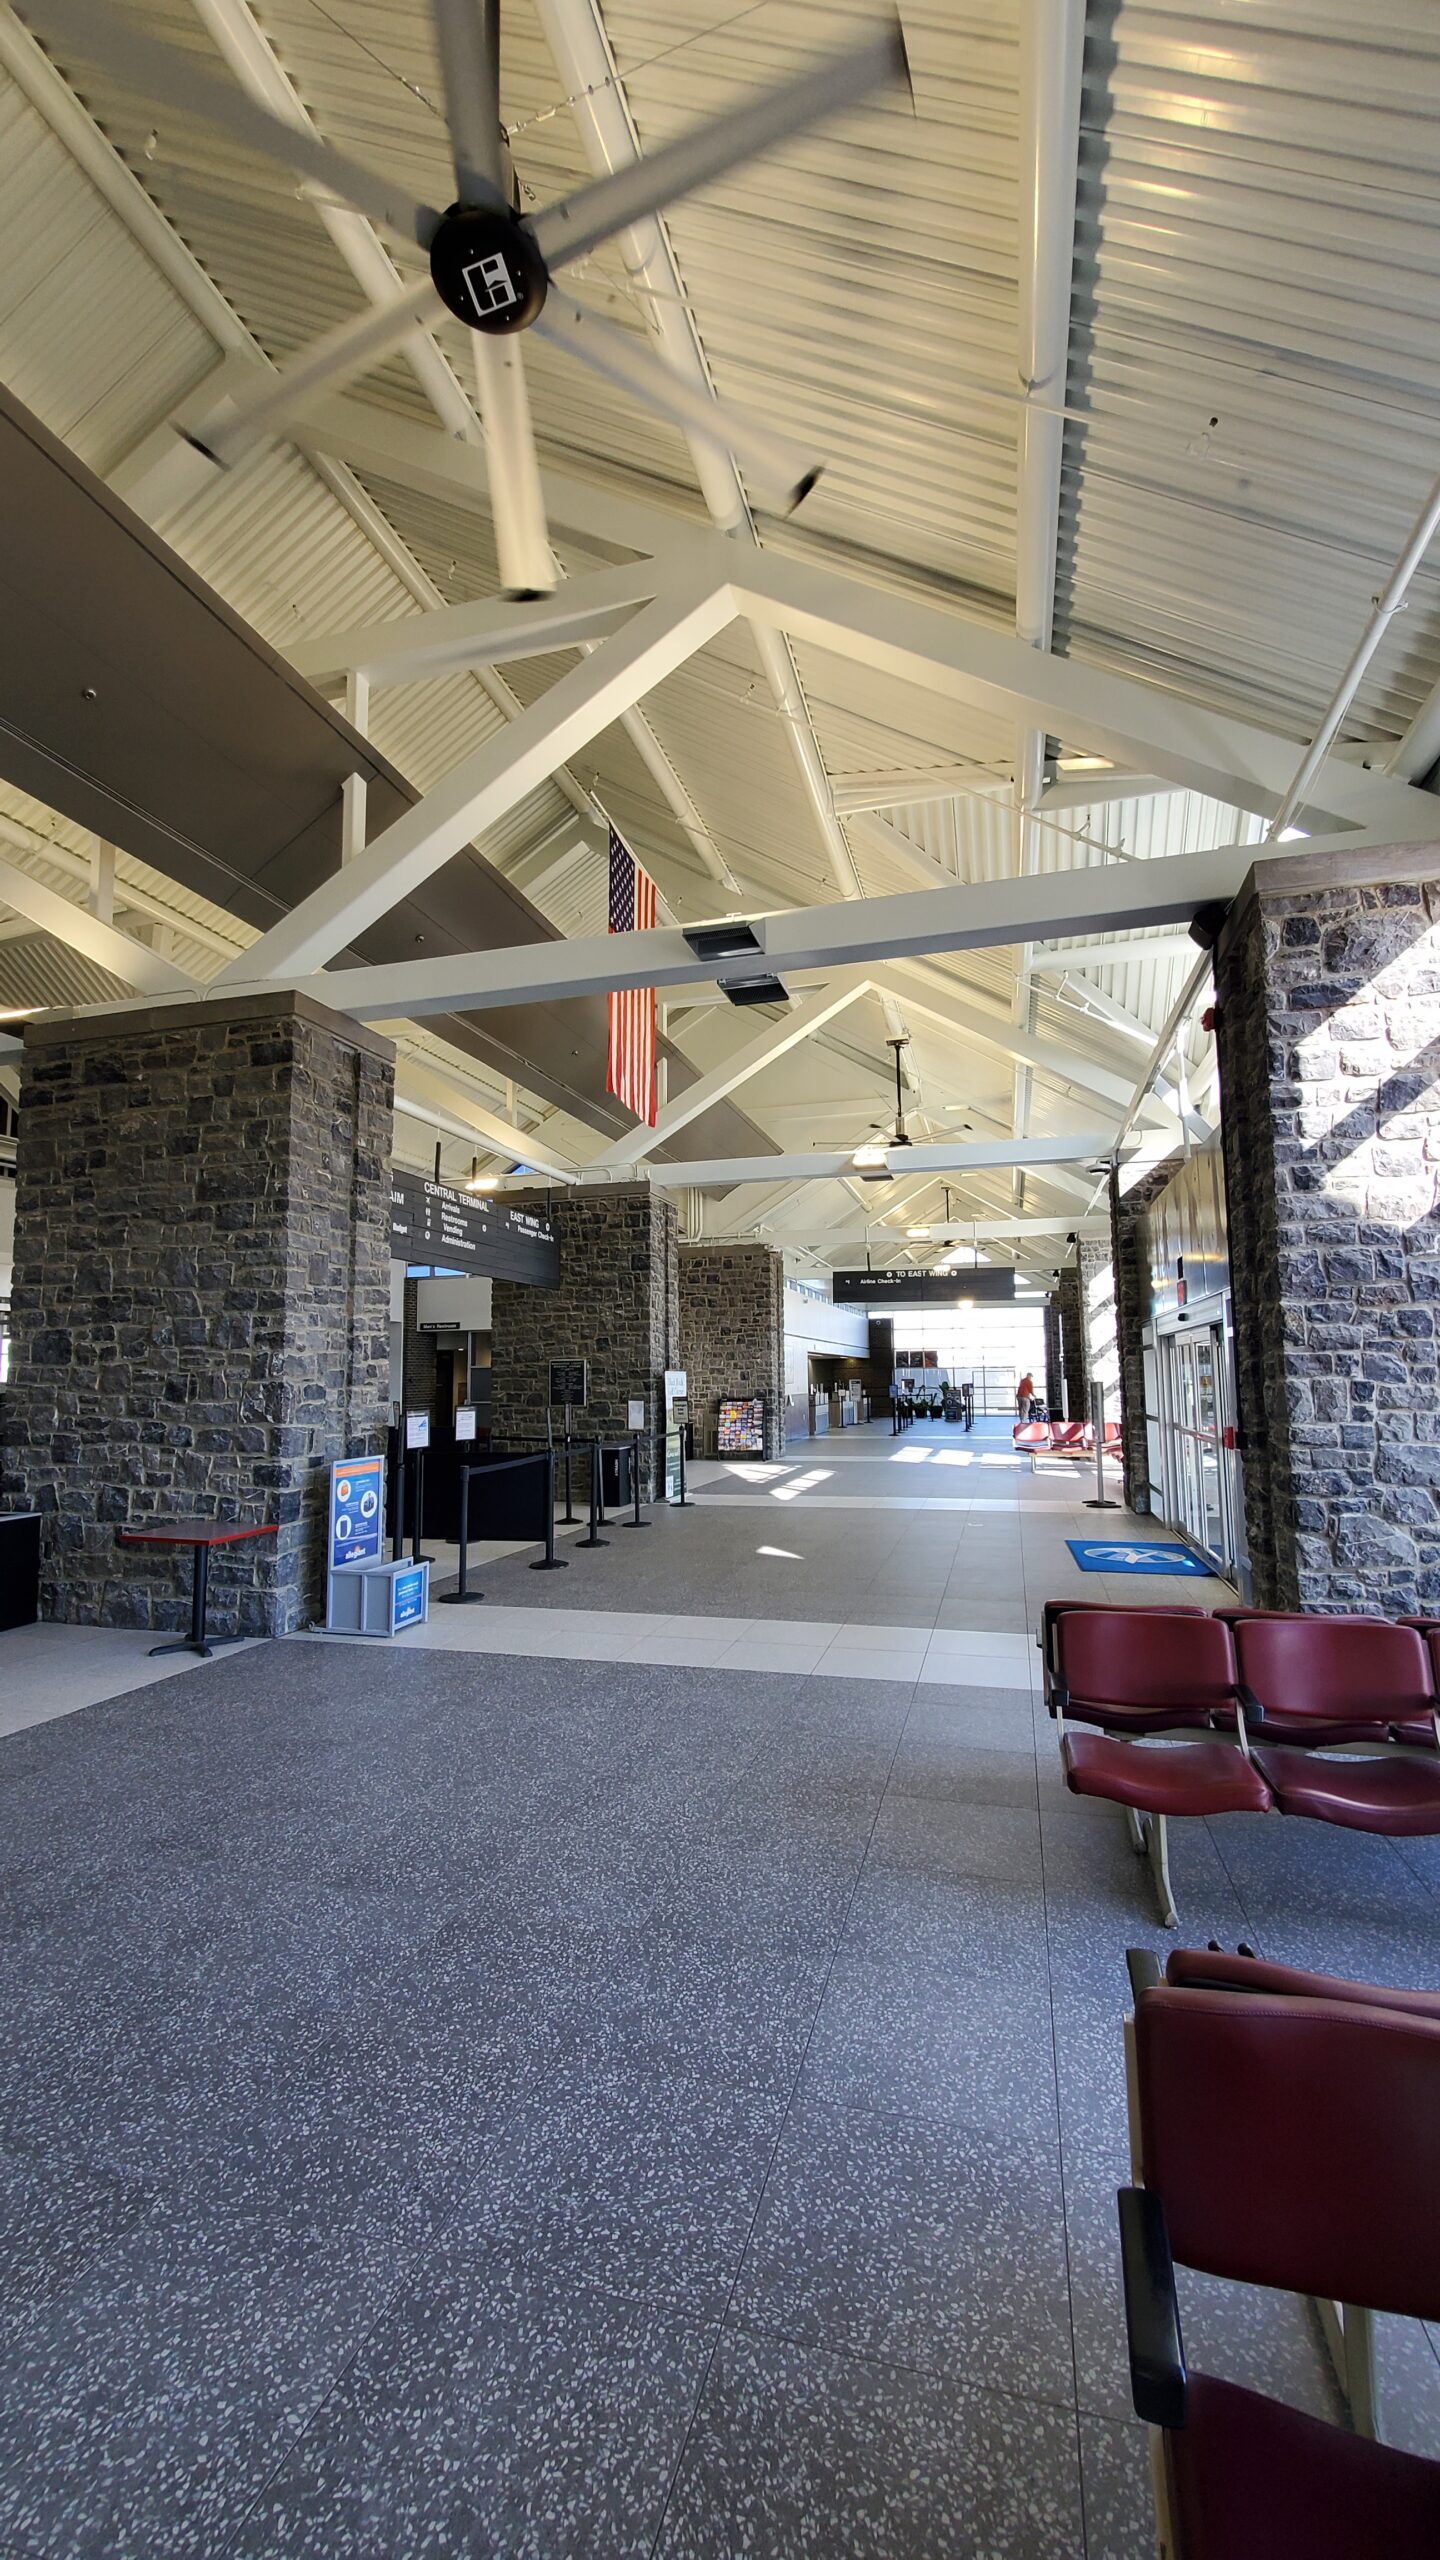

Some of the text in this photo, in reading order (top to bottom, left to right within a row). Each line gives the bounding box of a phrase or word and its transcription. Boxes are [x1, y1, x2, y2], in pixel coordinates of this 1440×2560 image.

[424, 1182, 490, 1212] CENTRAL TERMINAL
[441, 1201, 460, 1214] Arrivals
[441, 1211, 468, 1227] Restrooms
[510, 1210, 540, 1229] EAST WING
[443, 1222, 463, 1237] Vending
[517, 1225, 537, 1238] Passenger
[441, 1234, 476, 1251] Administration
[896, 1270, 906, 1278] TO
[907, 1270, 927, 1278] EAST
